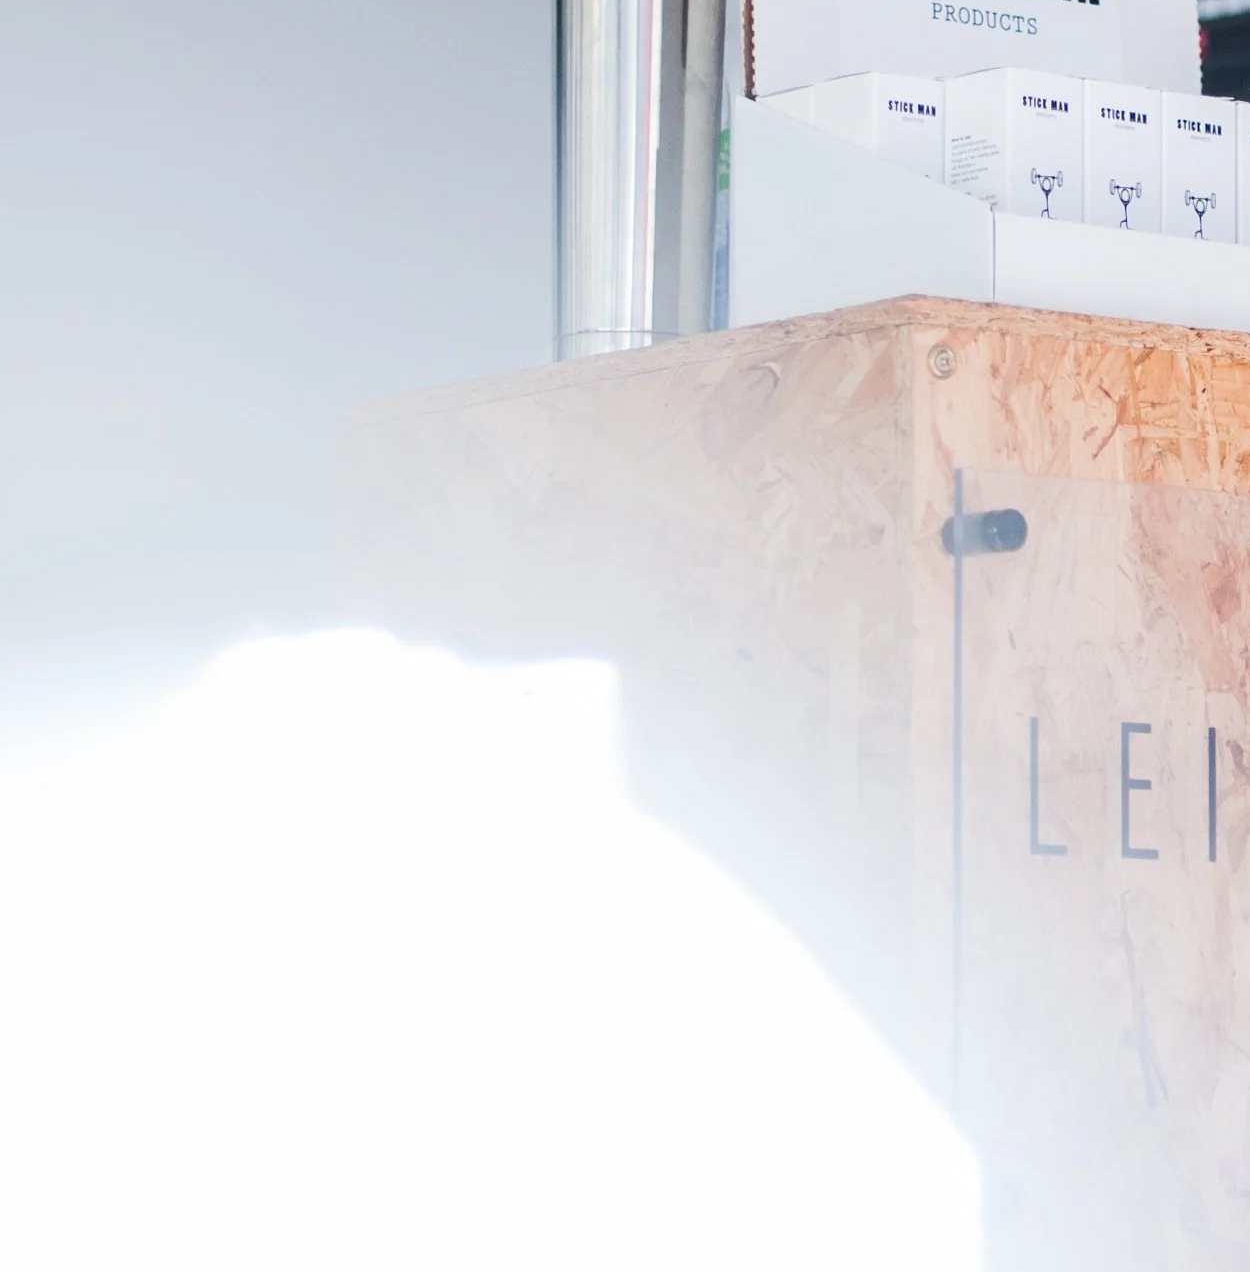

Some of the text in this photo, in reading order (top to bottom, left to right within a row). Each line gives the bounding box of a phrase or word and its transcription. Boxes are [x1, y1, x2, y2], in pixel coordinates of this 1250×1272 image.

[931, 1, 1038, 35] PRODUCTS
[888, 99, 937, 117] STICK MAN
[1022, 95, 1069, 113] STICK MAN
[1100, 107, 1147, 125] STICK MAN
[1177, 118, 1222, 136] STICK MAN
